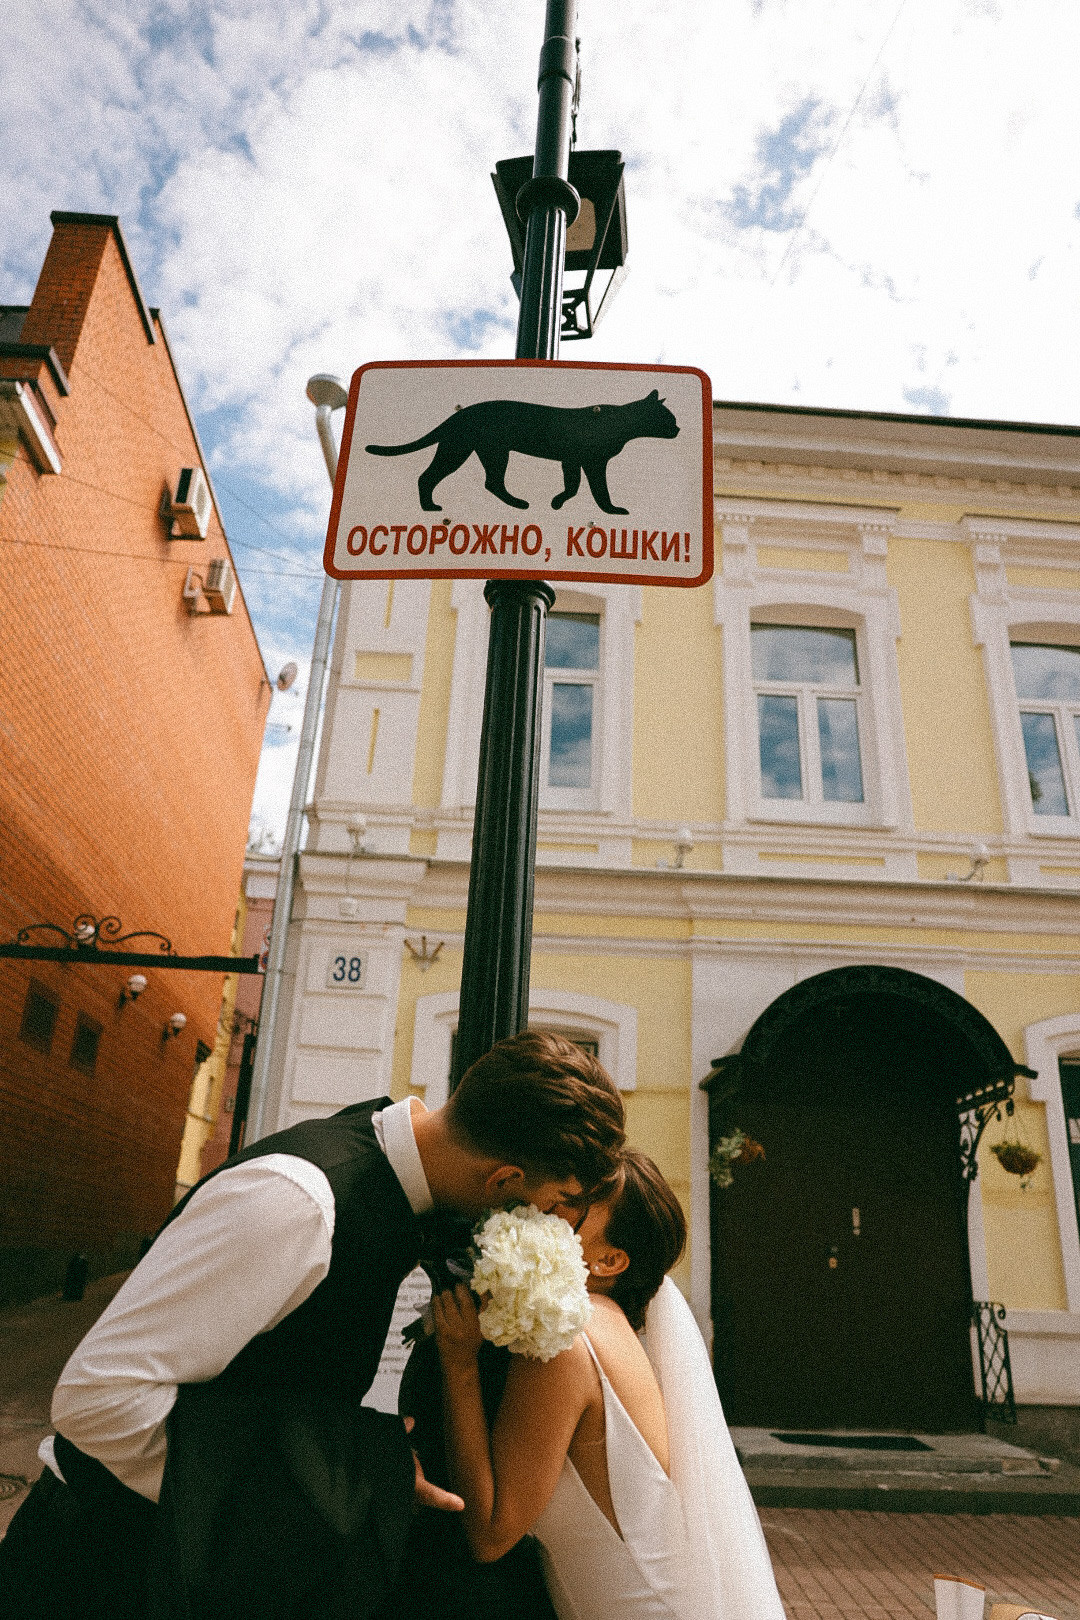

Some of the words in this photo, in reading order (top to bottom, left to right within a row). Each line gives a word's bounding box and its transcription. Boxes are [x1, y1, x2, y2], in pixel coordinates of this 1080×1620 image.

[346, 523, 552, 562] ОСТОРОЖНО,
[566, 526, 691, 563] КОШКИ!
[333, 956, 361, 982] 38
